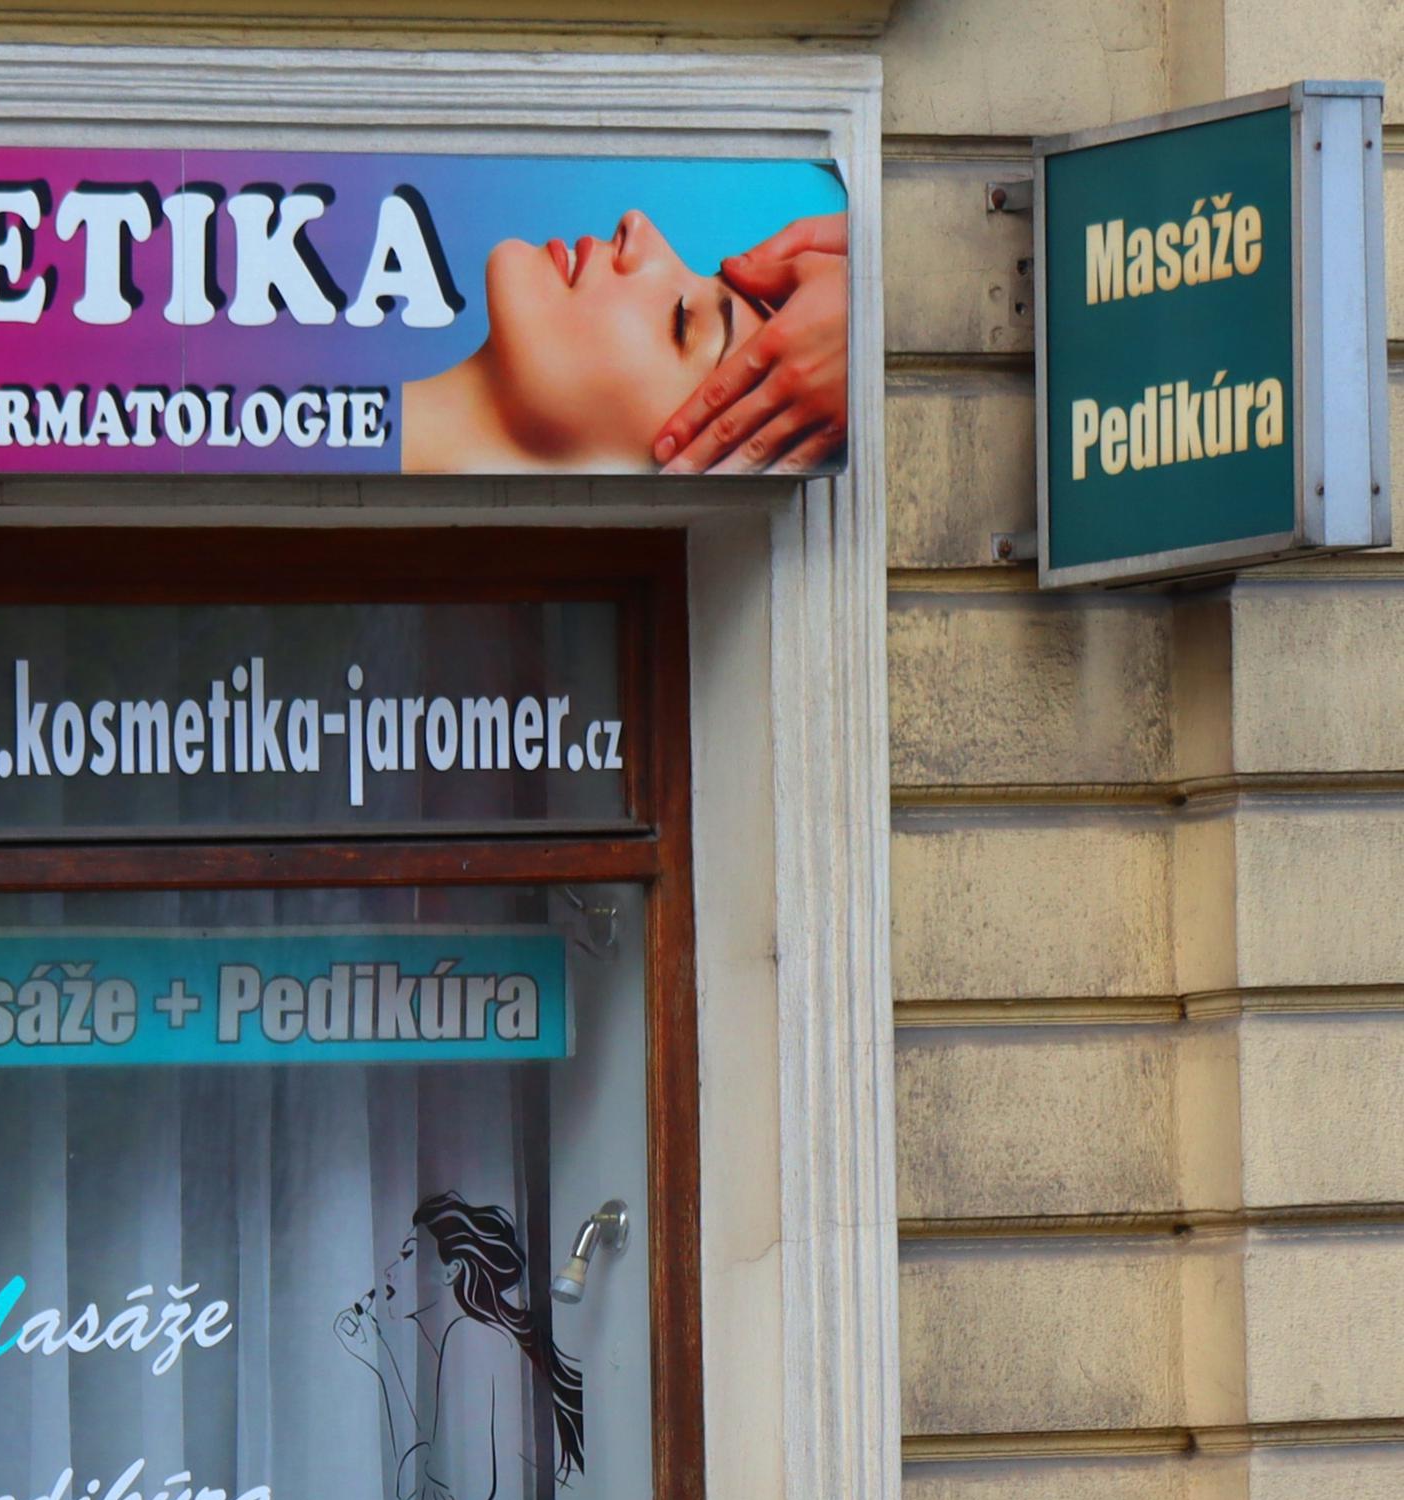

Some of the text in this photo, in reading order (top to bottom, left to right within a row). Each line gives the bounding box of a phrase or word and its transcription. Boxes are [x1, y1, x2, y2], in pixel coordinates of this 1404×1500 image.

[1085, 192, 1263, 306] Masáže
[1071, 369, 1285, 482] Pedikúra
[155, 976, 200, 1030] +
[216, 957, 541, 1044] Pedikúra
